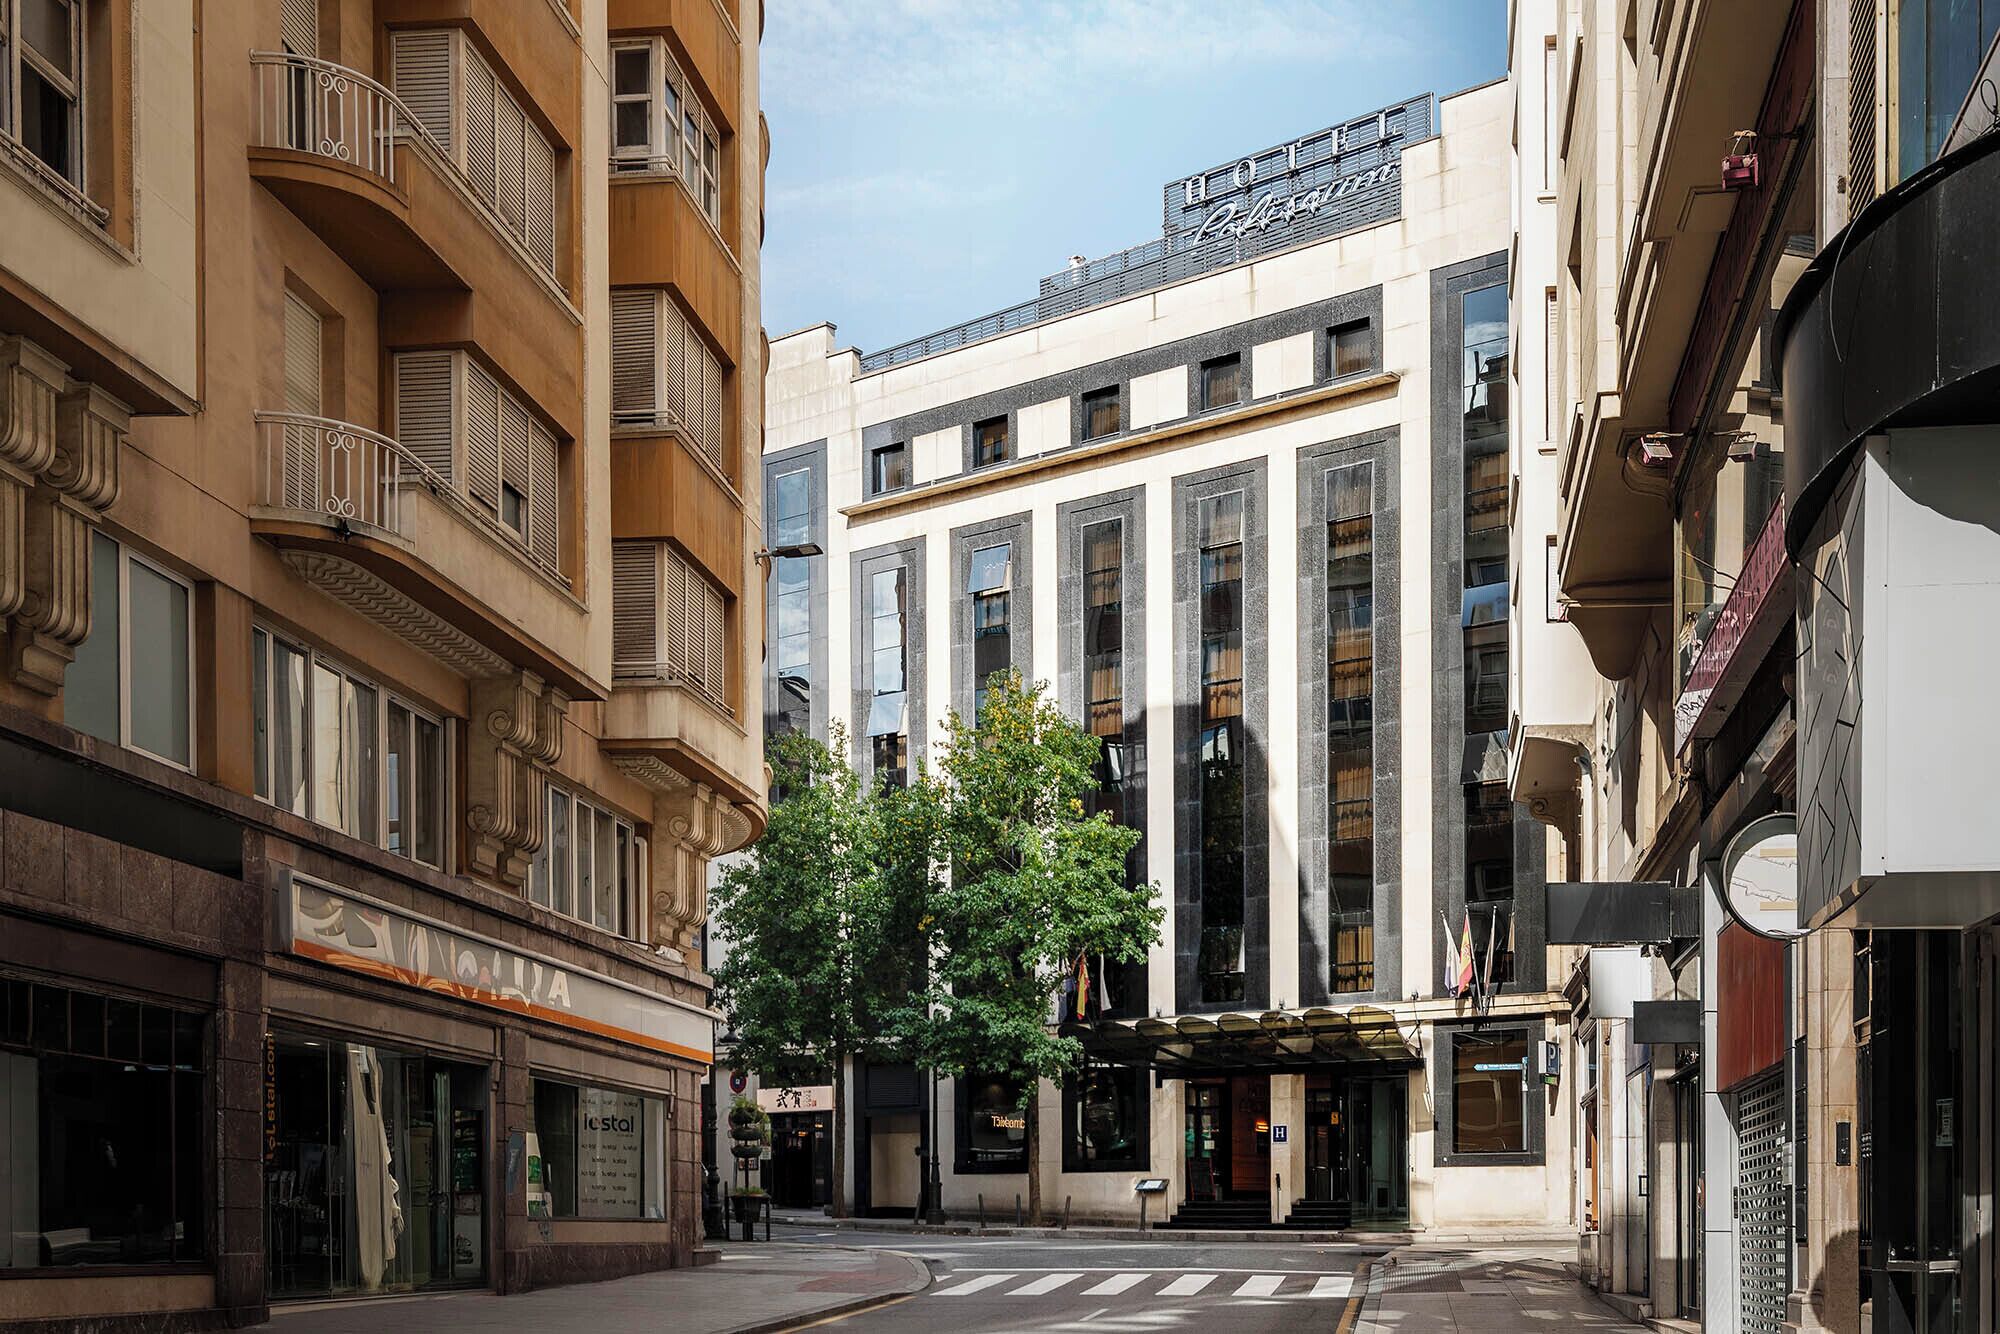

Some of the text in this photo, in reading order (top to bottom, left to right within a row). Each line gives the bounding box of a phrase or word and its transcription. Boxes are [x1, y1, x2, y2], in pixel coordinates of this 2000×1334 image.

[1182, 107, 1403, 206] HOTEL
[1548, 1044, 1556, 1067] P
[1275, 1127, 1285, 1138] H
